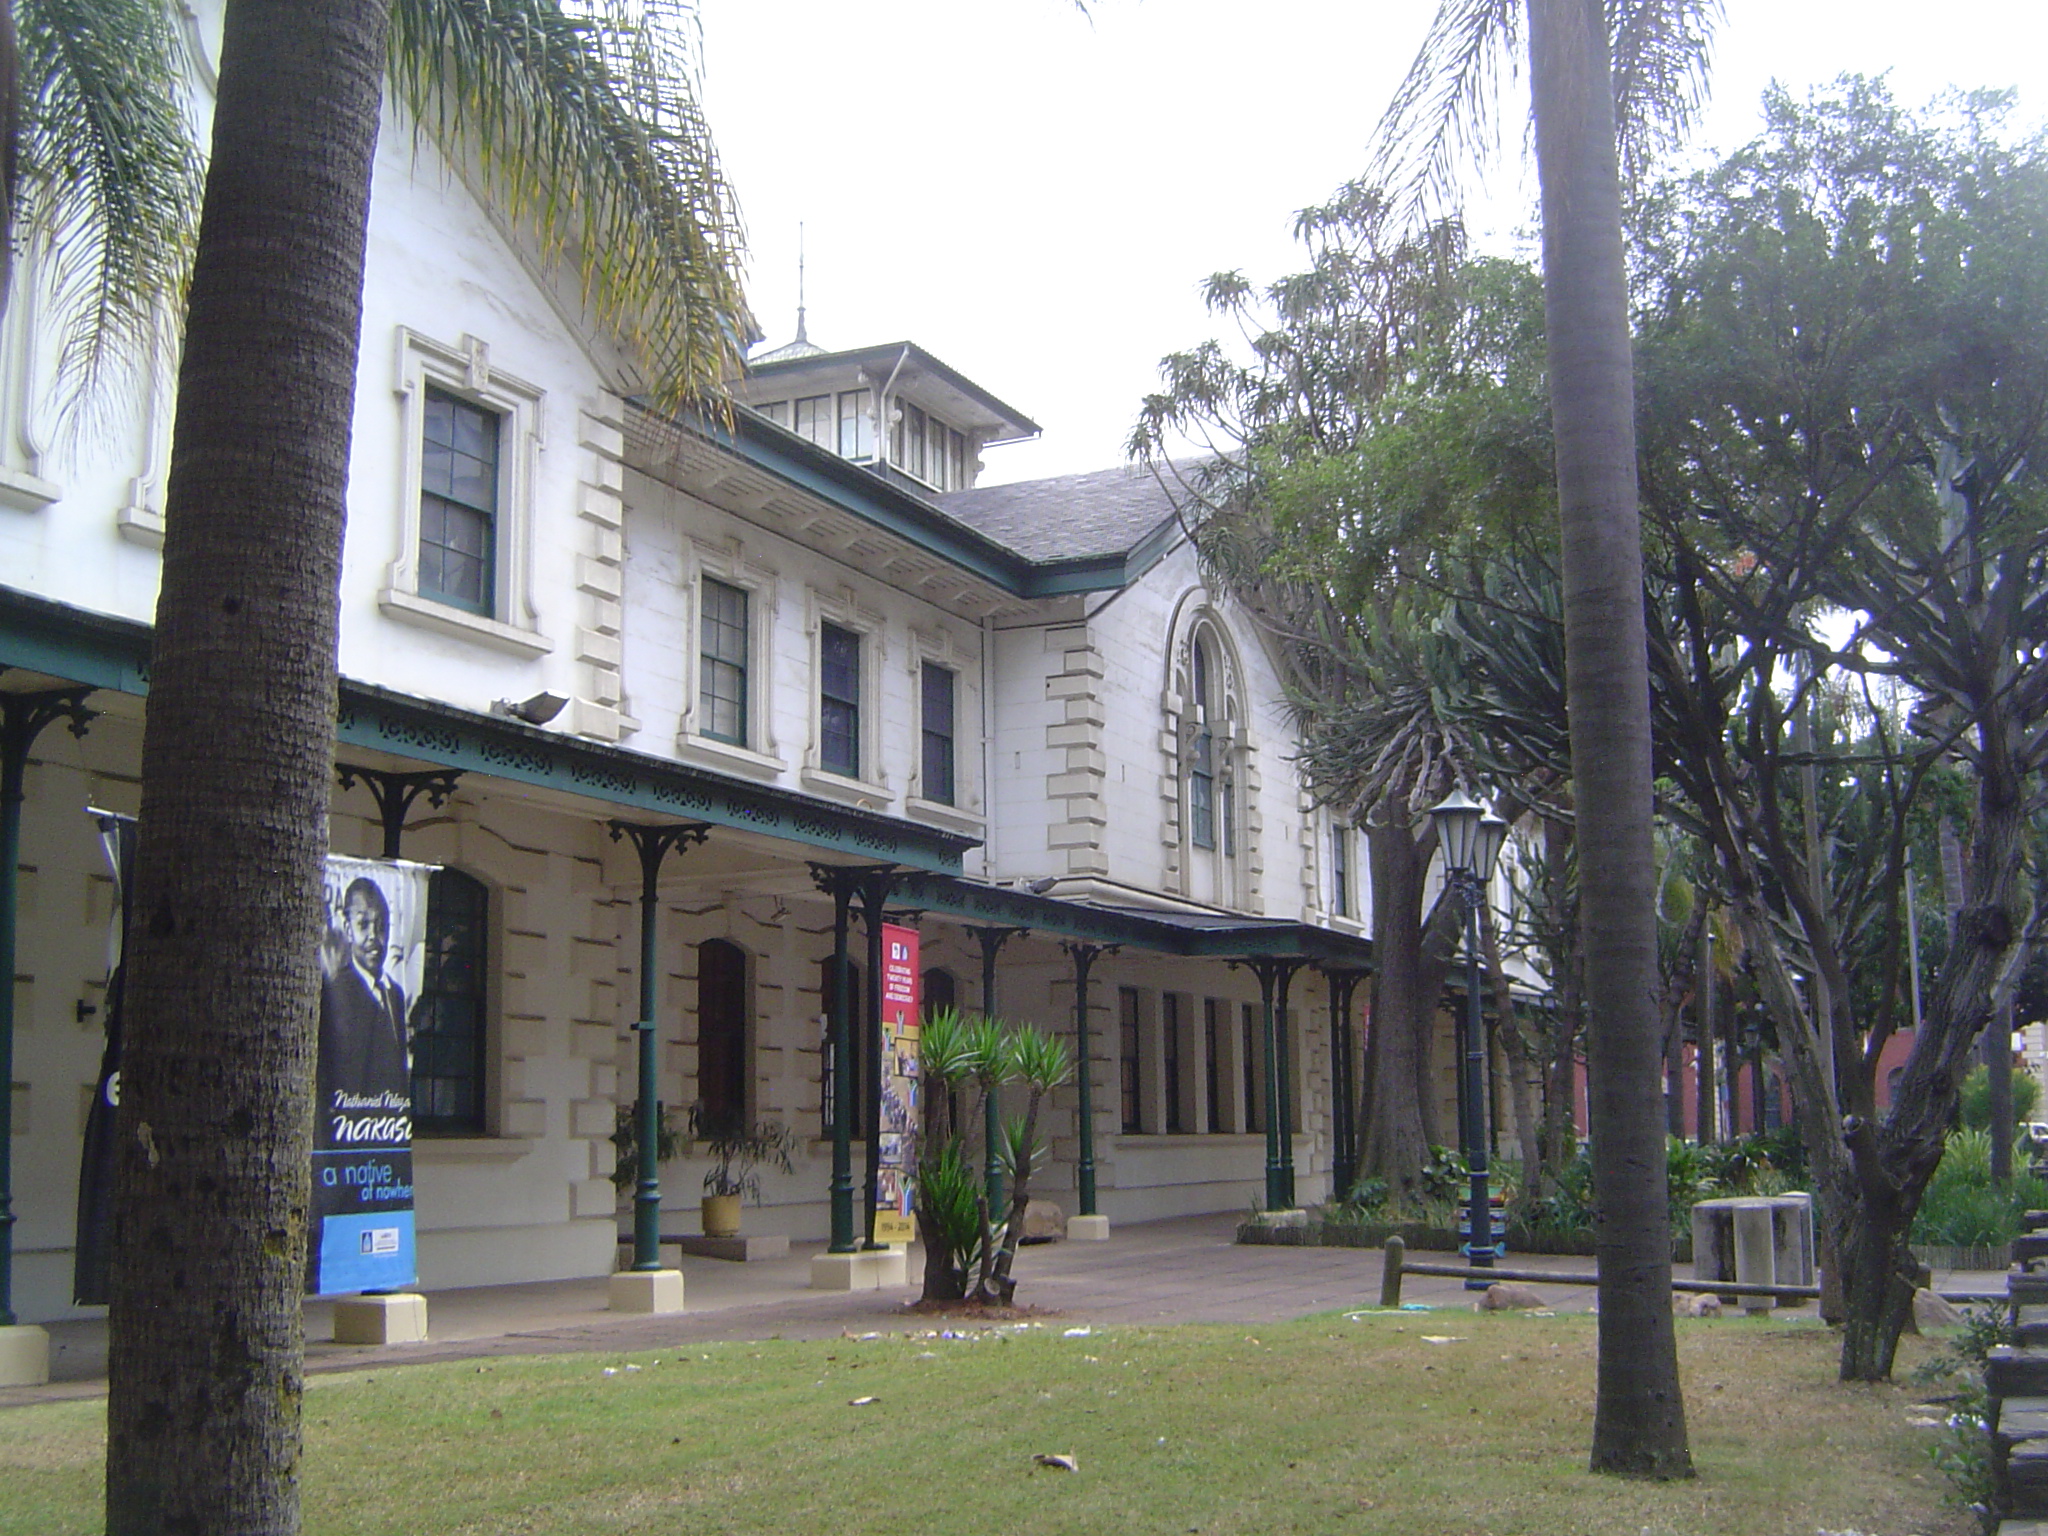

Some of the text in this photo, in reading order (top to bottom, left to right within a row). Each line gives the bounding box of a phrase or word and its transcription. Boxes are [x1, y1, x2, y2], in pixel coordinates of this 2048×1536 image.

[323, 1158, 393, 1186] a native
[361, 1180, 374, 1201] of
